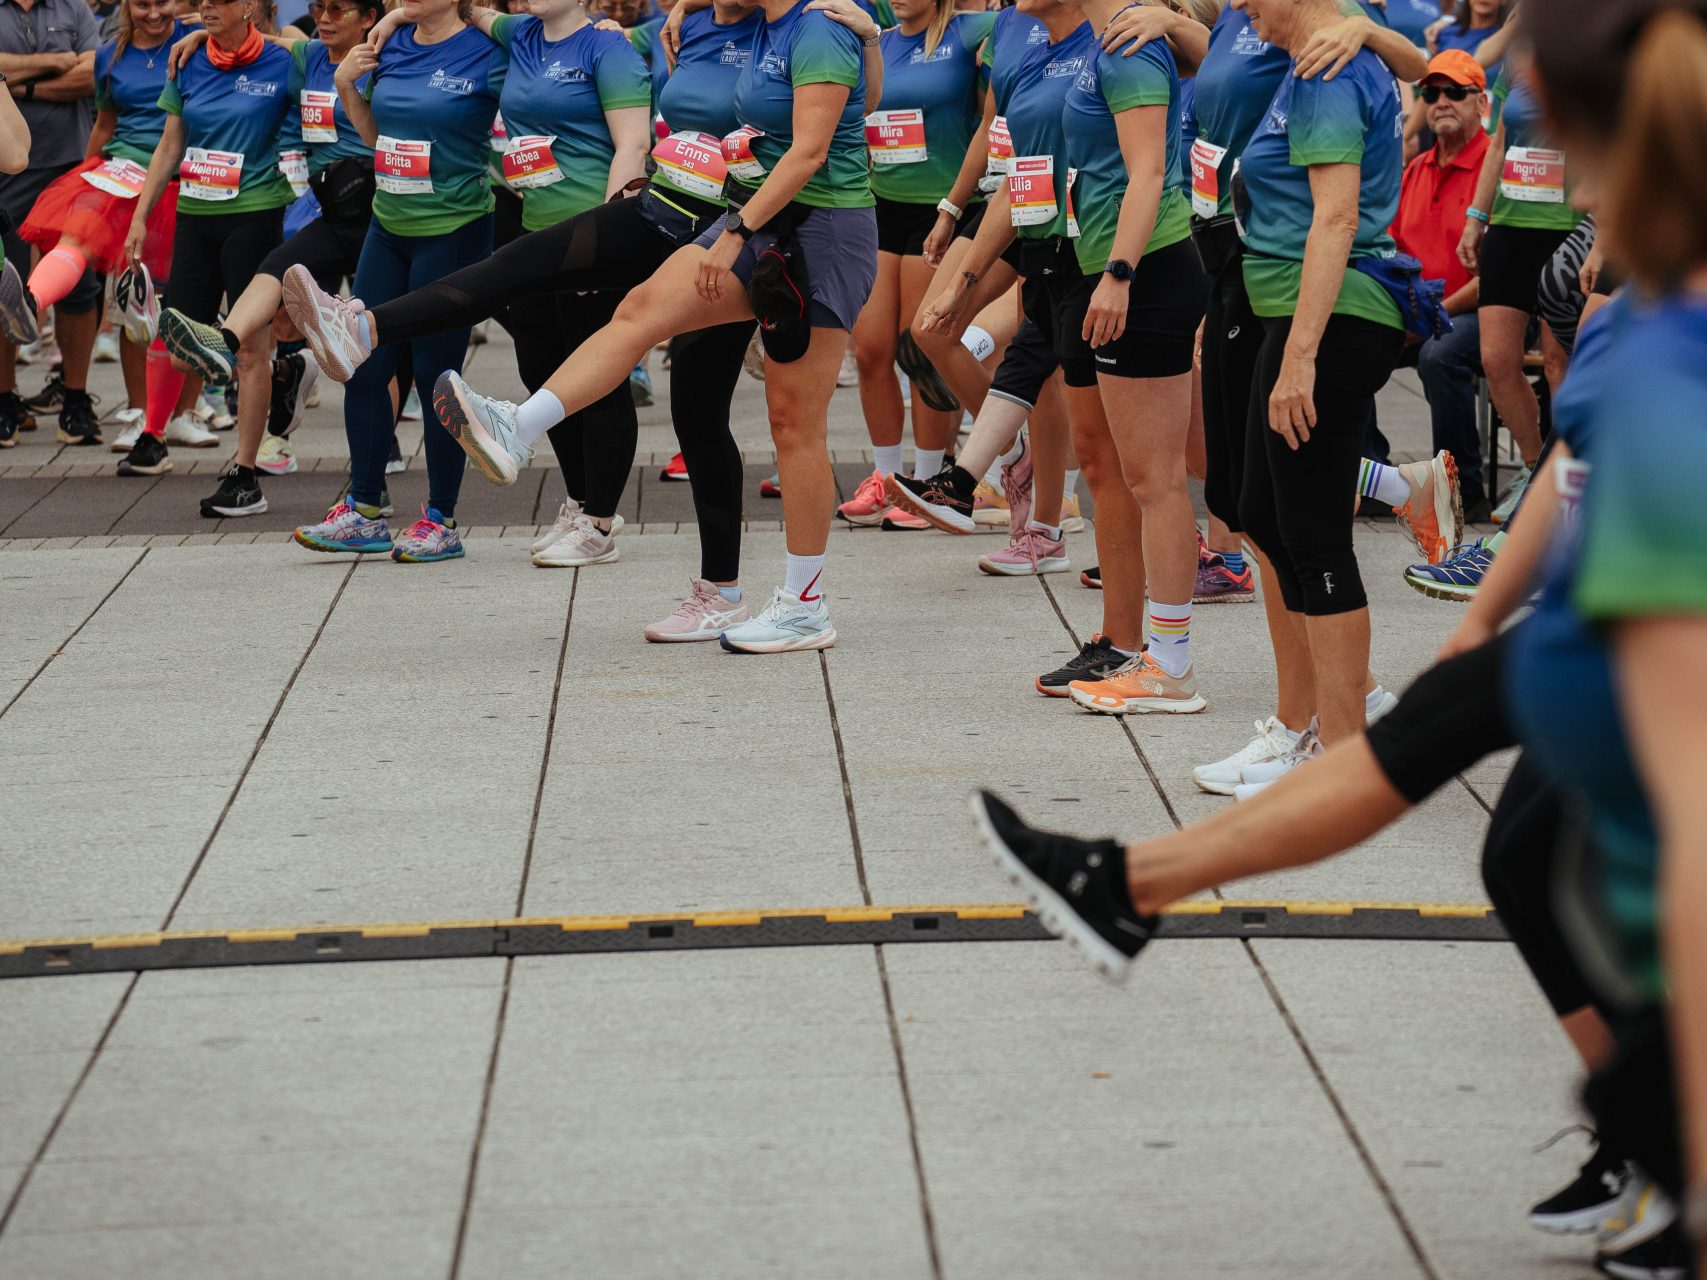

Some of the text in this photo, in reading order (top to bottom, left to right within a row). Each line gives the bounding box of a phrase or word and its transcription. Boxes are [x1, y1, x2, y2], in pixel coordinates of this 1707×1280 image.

[879, 126, 904, 138] Mira
[510, 150, 540, 166] Tabea
[675, 140, 711, 164] Enns
[385, 153, 412, 168] Britta
[681, 159, 695, 169] 343
[189, 162, 228, 177] Helene
[1513, 160, 1547, 177] Ingrid
[1009, 176, 1032, 192] Lilia
